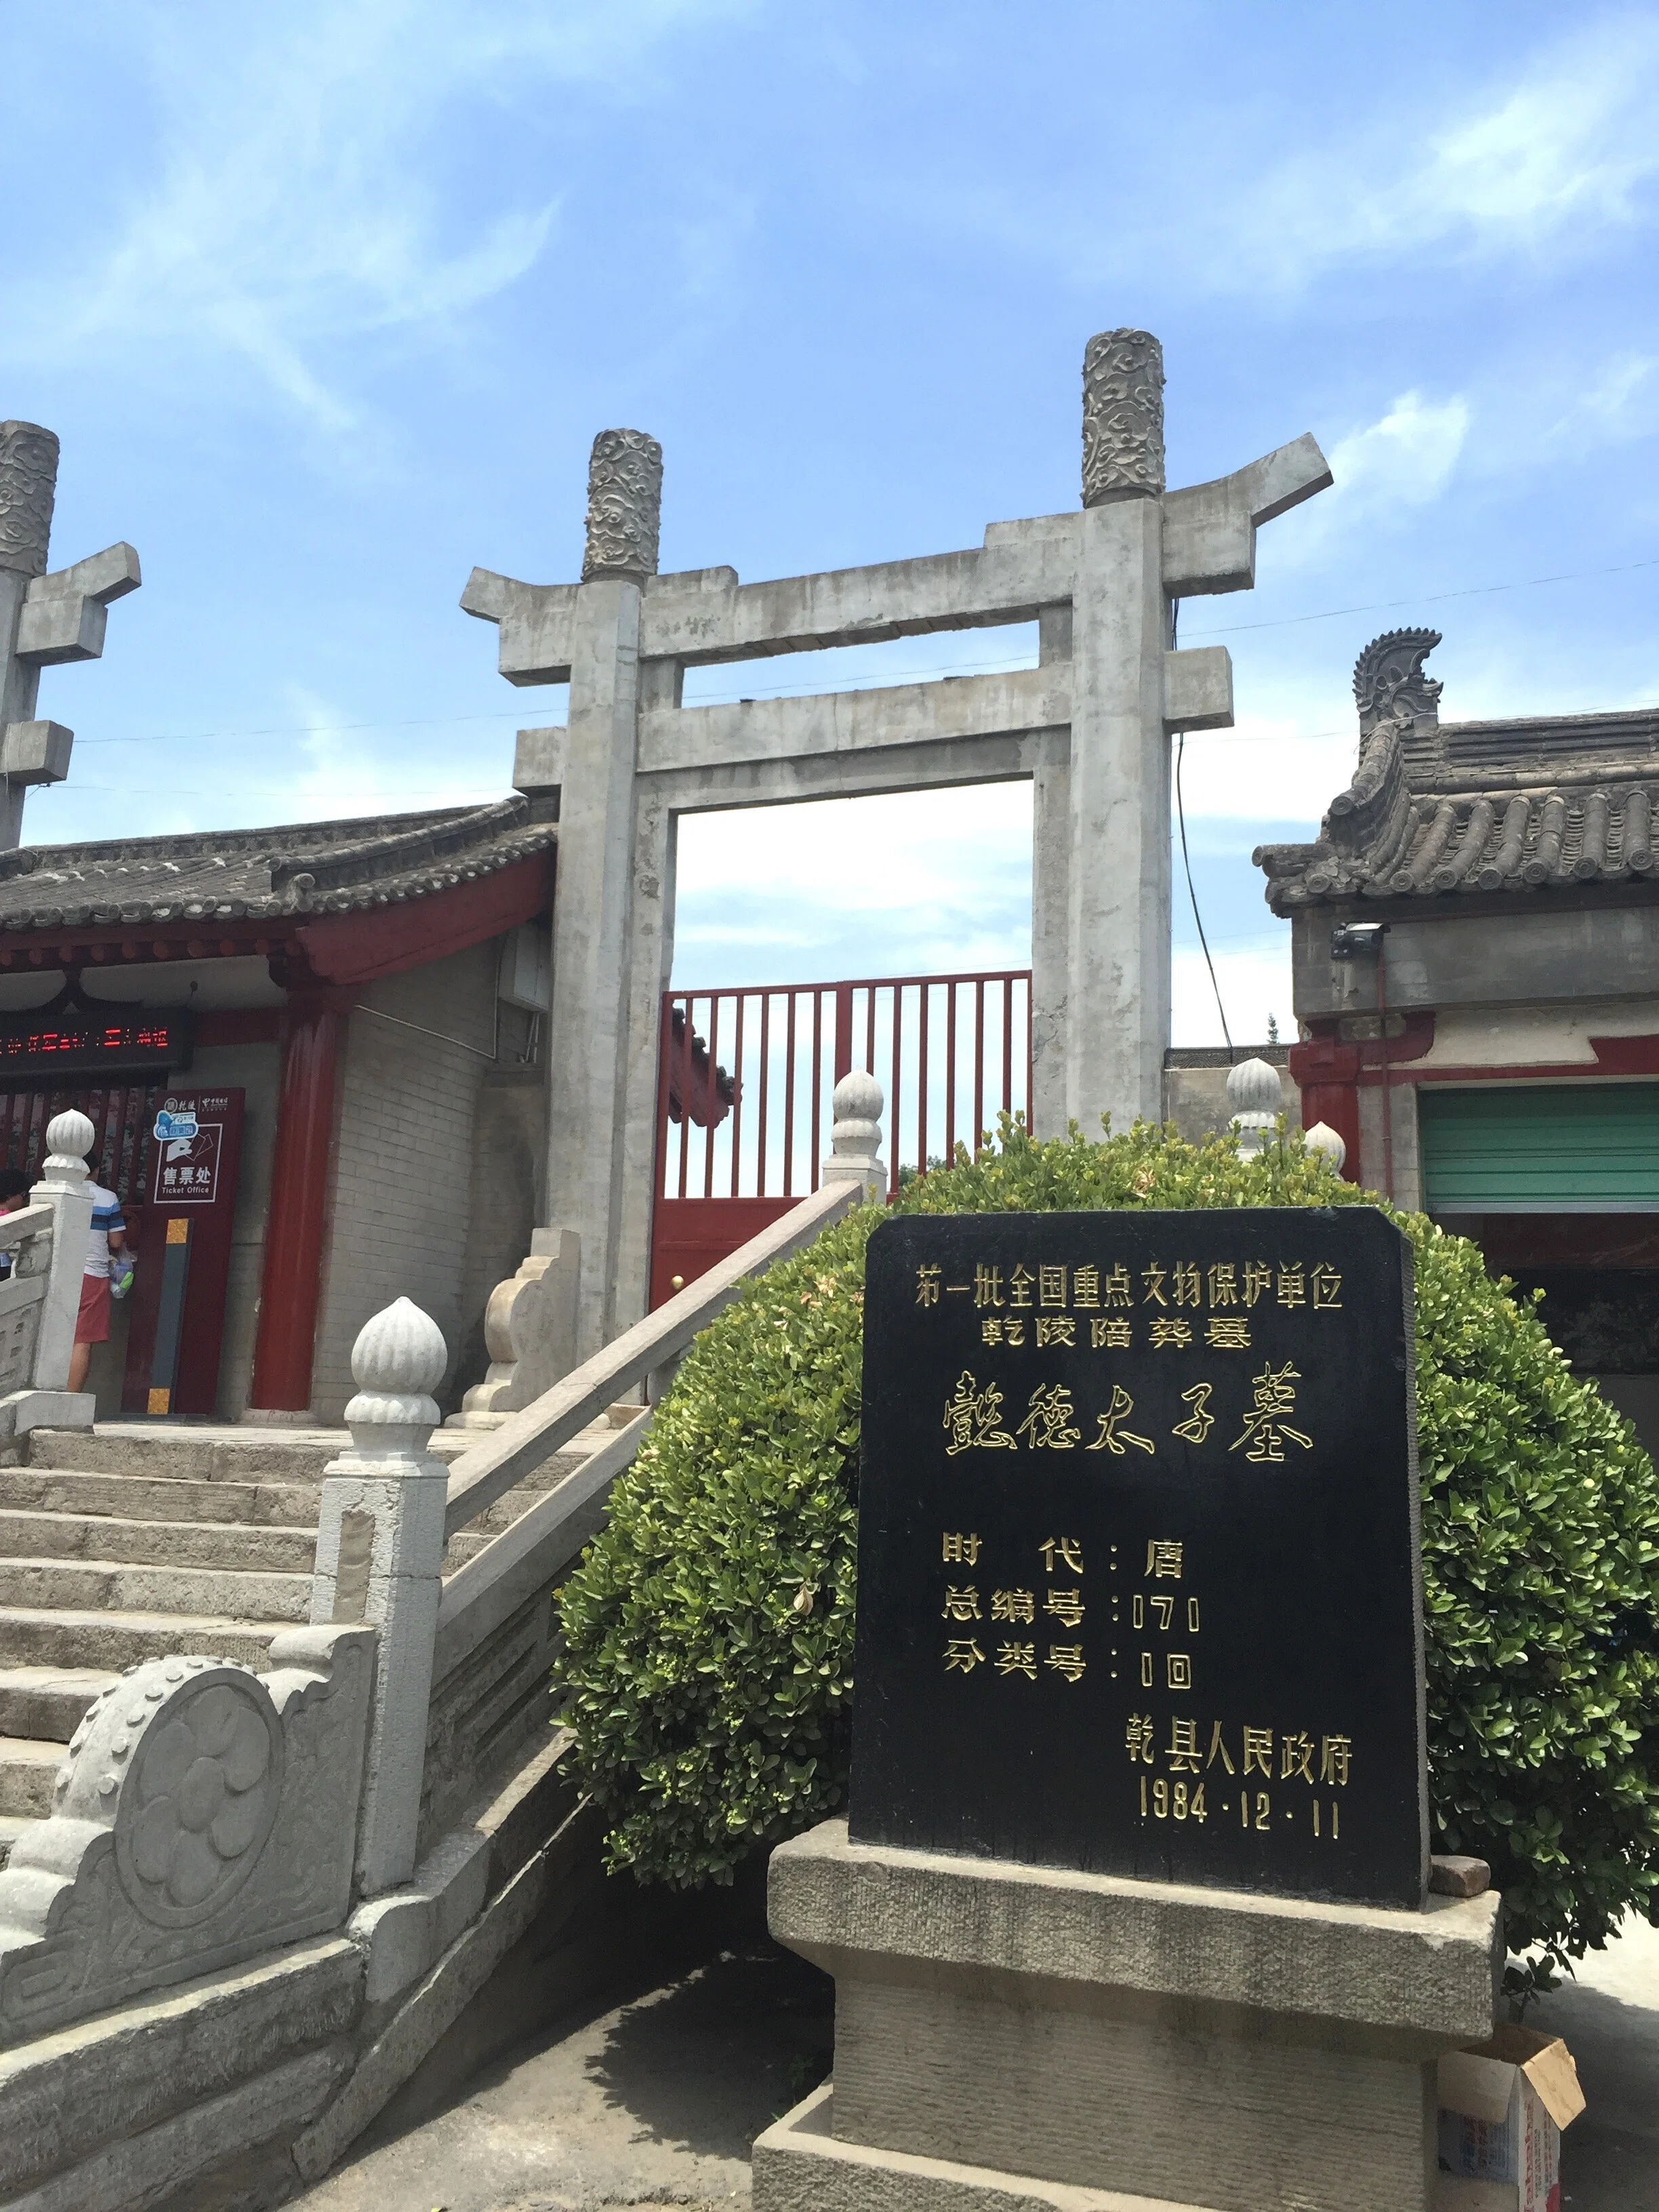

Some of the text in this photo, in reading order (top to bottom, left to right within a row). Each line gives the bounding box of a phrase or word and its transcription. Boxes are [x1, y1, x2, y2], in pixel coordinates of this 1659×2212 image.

[163, 1166, 211, 1185] 售票处
[982, 1315, 1252, 1349] 乾陵陪葬墓
[1125, 1713, 1353, 1786] 乾县人民政府
